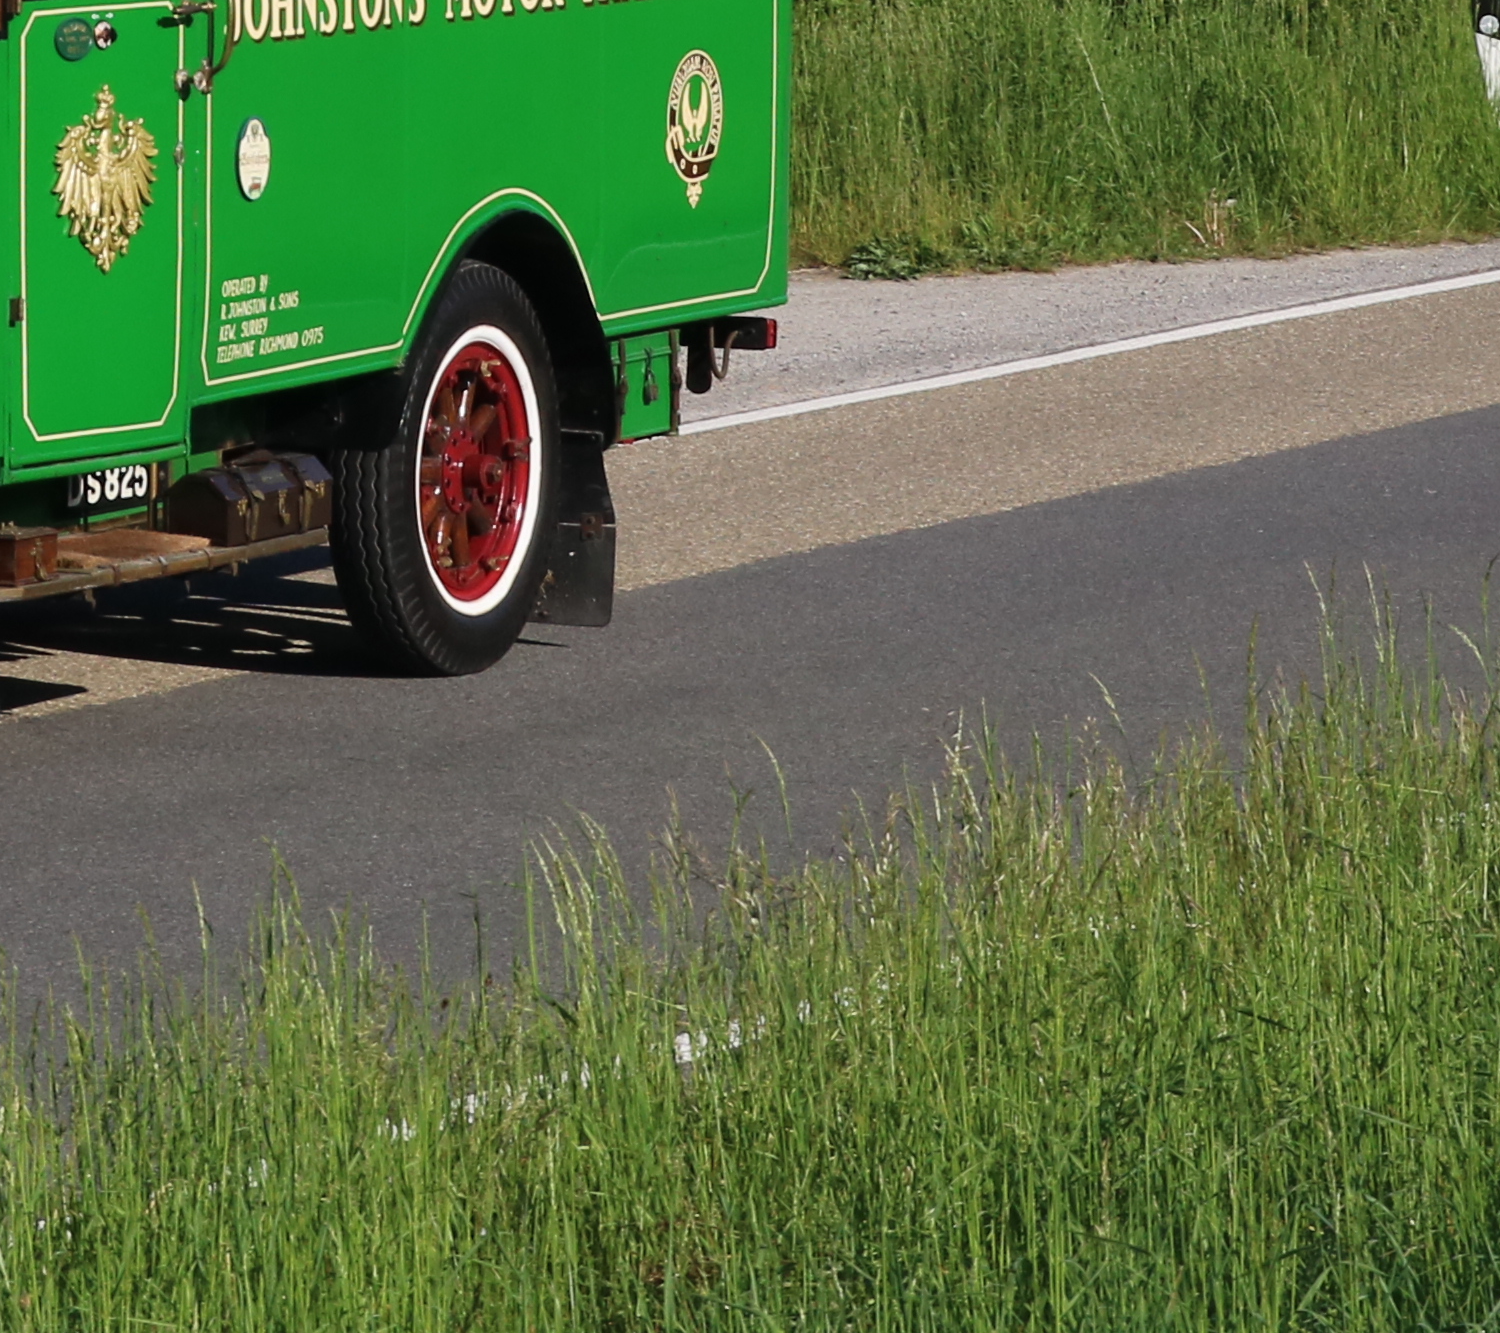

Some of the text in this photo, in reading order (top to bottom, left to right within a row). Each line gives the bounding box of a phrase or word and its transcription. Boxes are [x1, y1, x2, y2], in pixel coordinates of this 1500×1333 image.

[221, 276, 256, 298] OPERATED
[269, 296, 276, 311] &
[278, 290, 299, 309] SONS
[241, 317, 268, 337] SURREY
[216, 326, 324, 363] TELEPHONE RICHMOND 0975
